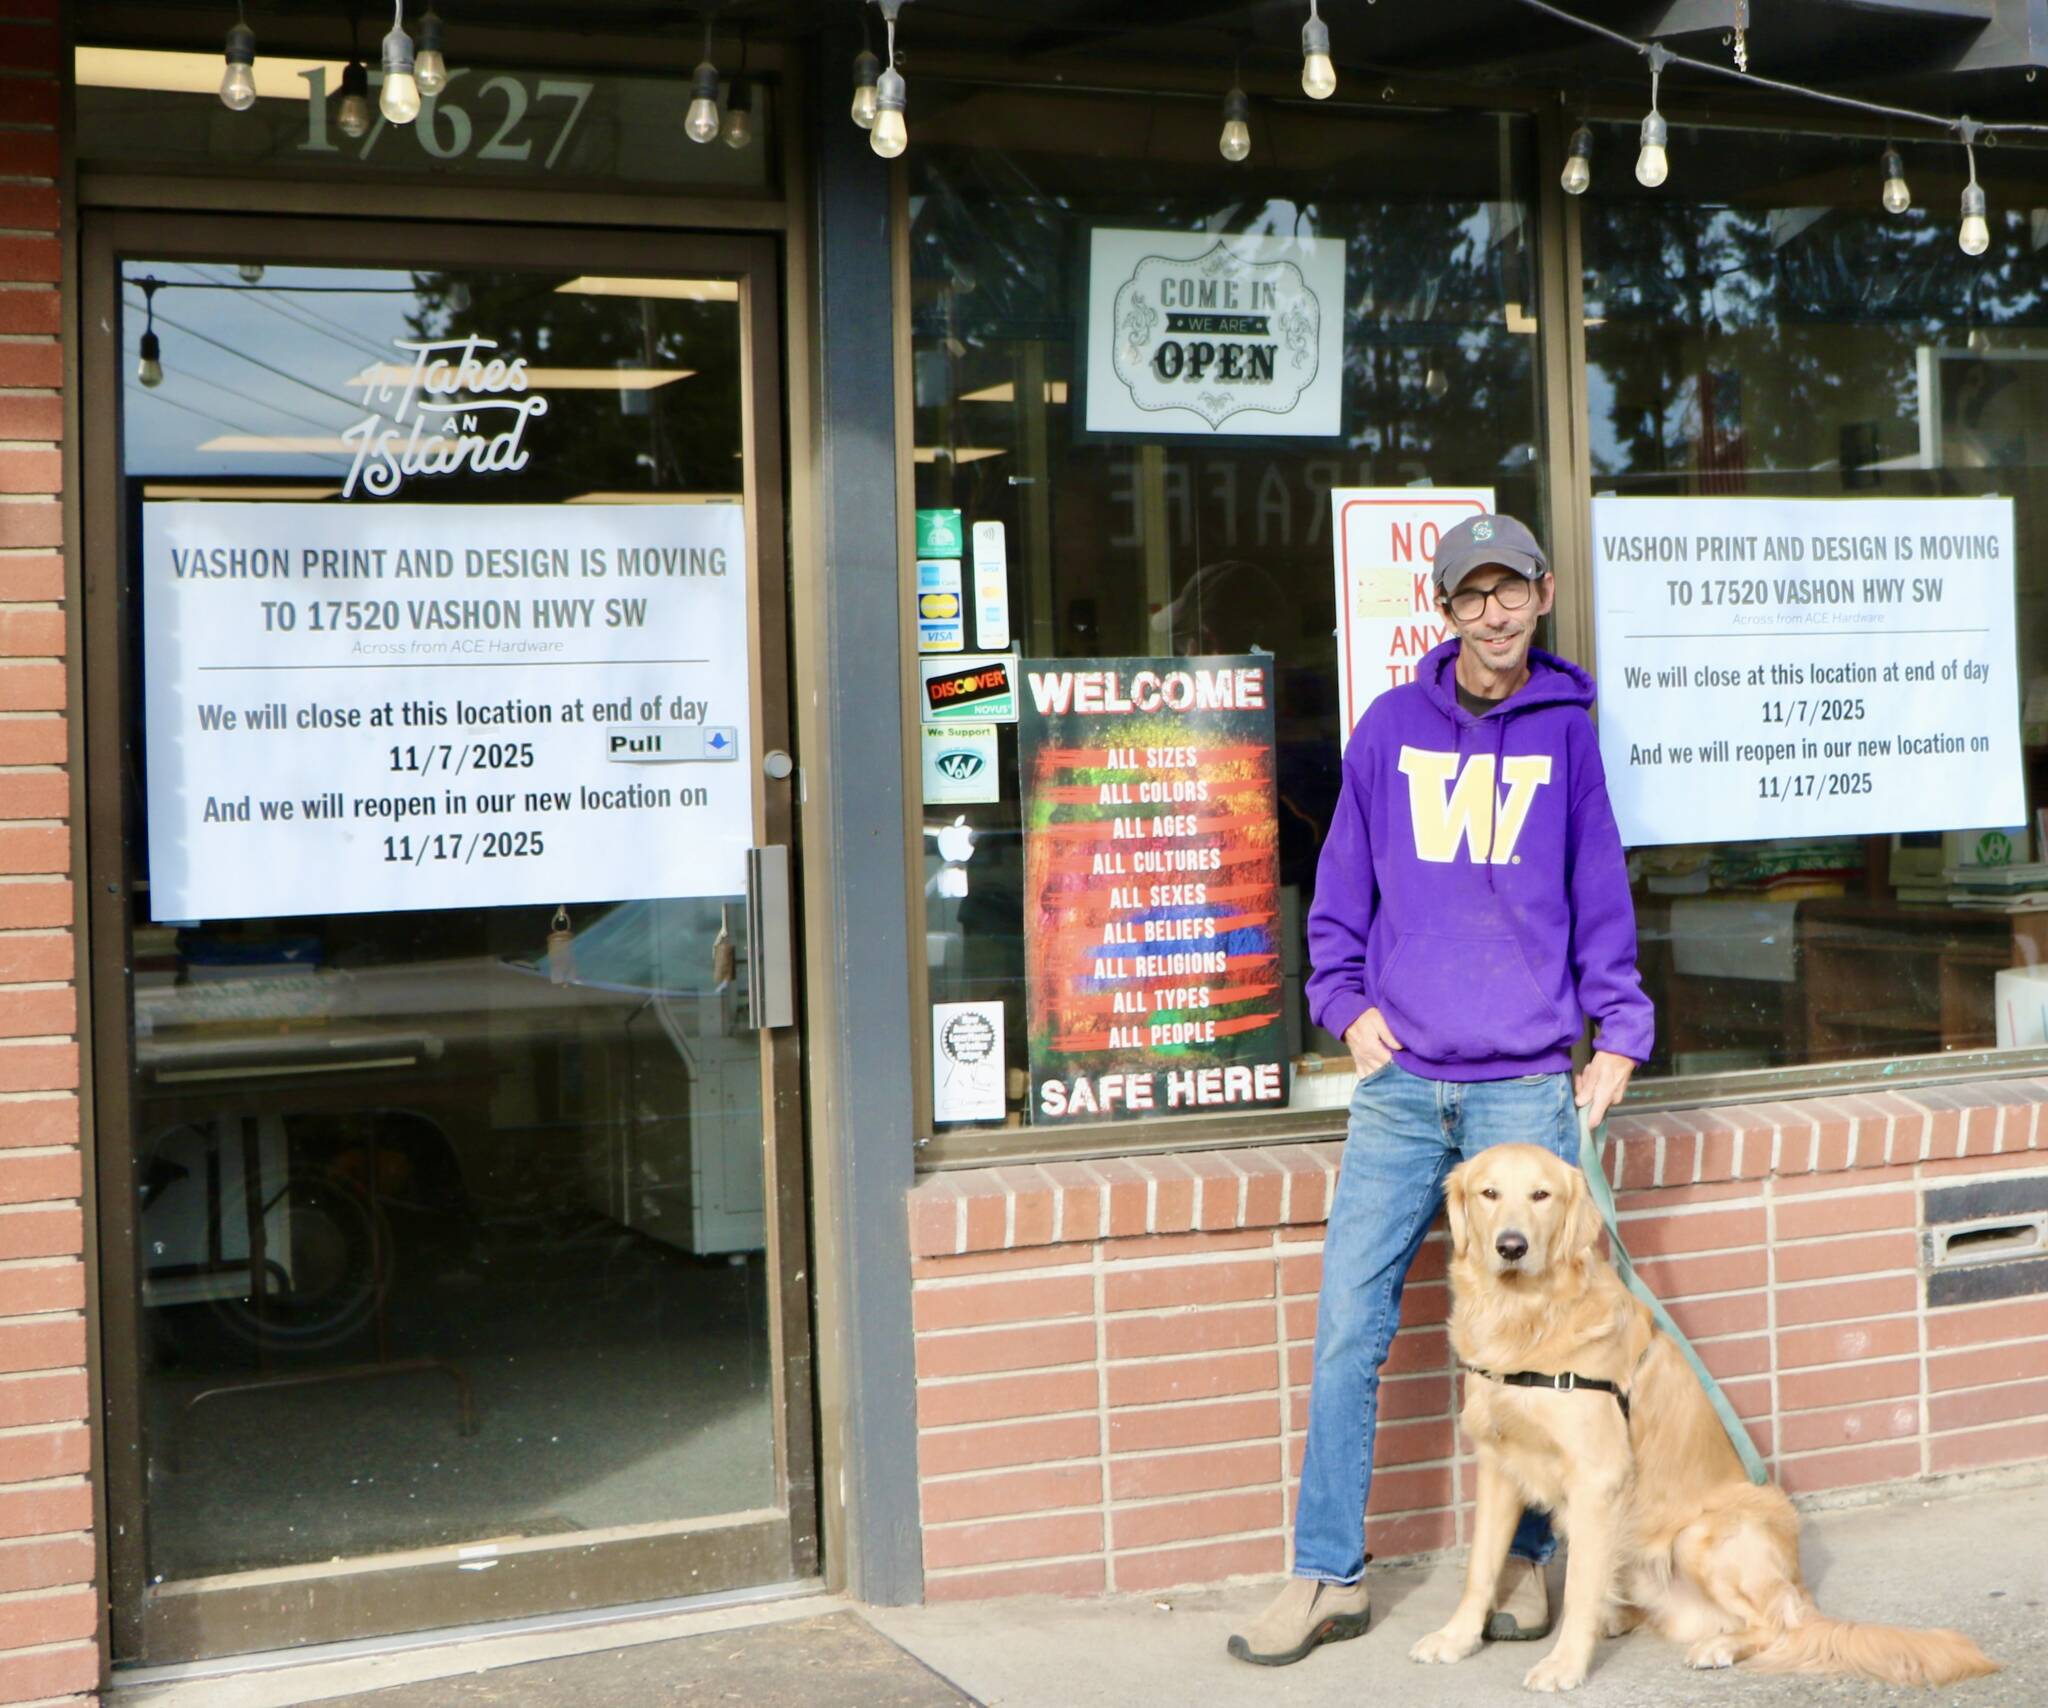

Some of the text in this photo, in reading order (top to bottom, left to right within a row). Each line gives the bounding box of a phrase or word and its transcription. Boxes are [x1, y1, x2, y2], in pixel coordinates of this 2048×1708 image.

[297, 66, 595, 169] 17627
[1160, 278, 1277, 310] COME IN
[1188, 317, 1248, 332] WE ARE
[1152, 340, 1278, 384] OPEN
[394, 333, 528, 423] Takes
[442, 414, 478, 434] AN
[341, 396, 548, 498] Island
[171, 547, 727, 578] VASHON PRINT AND DESIGN IS MOVING
[1603, 535, 1999, 561] VASHON PRINT AND DESIGN IS MOVING
[1667, 578, 1943, 606] TO 17520 VASHON HWY SW
[261, 598, 647, 631] TO 17520 VASHON HWY SW
[1732, 612, 1884, 625] Across from ACE Hardware
[352, 638, 564, 655] Across from ACE Hardware
[927, 631, 953, 642] VISA
[930, 671, 1005, 700] DISCOVER
[1624, 659, 1989, 688] We will close at this location at end of day
[1028, 668, 1265, 715] WELCOME
[198, 695, 708, 731] We will close at this location at end of day
[974, 706, 1009, 715] NOVUS
[1762, 699, 1865, 728] 11/7/2025
[610, 735, 662, 753] Pull
[927, 728, 991, 738] We Support
[390, 743, 534, 776] 11/7/2025
[1107, 747, 1197, 770] ALL SIZES
[1630, 733, 1989, 765] And we will reopen in our new location on
[1099, 780, 1208, 805] ALL COLORS
[1759, 772, 1872, 802] 11/17/2025
[203, 784, 708, 822] And we will reopen in our new location on
[1398, 744, 1552, 864] W
[1113, 815, 1197, 840] ALL AGES
[384, 831, 544, 866] 11/17/2025
[1092, 848, 1221, 875] ALL CULTURES
[1110, 883, 1206, 909] ALL SEXES
[1103, 917, 1216, 944] ALL BELIEFS
[1094, 951, 1226, 980] ALL RELIGIONS
[1113, 987, 1209, 1014] ALL TYPES
[1109, 1021, 1215, 1049] ALL PEOPLE
[1041, 1063, 1281, 1116] SAFE HERE
